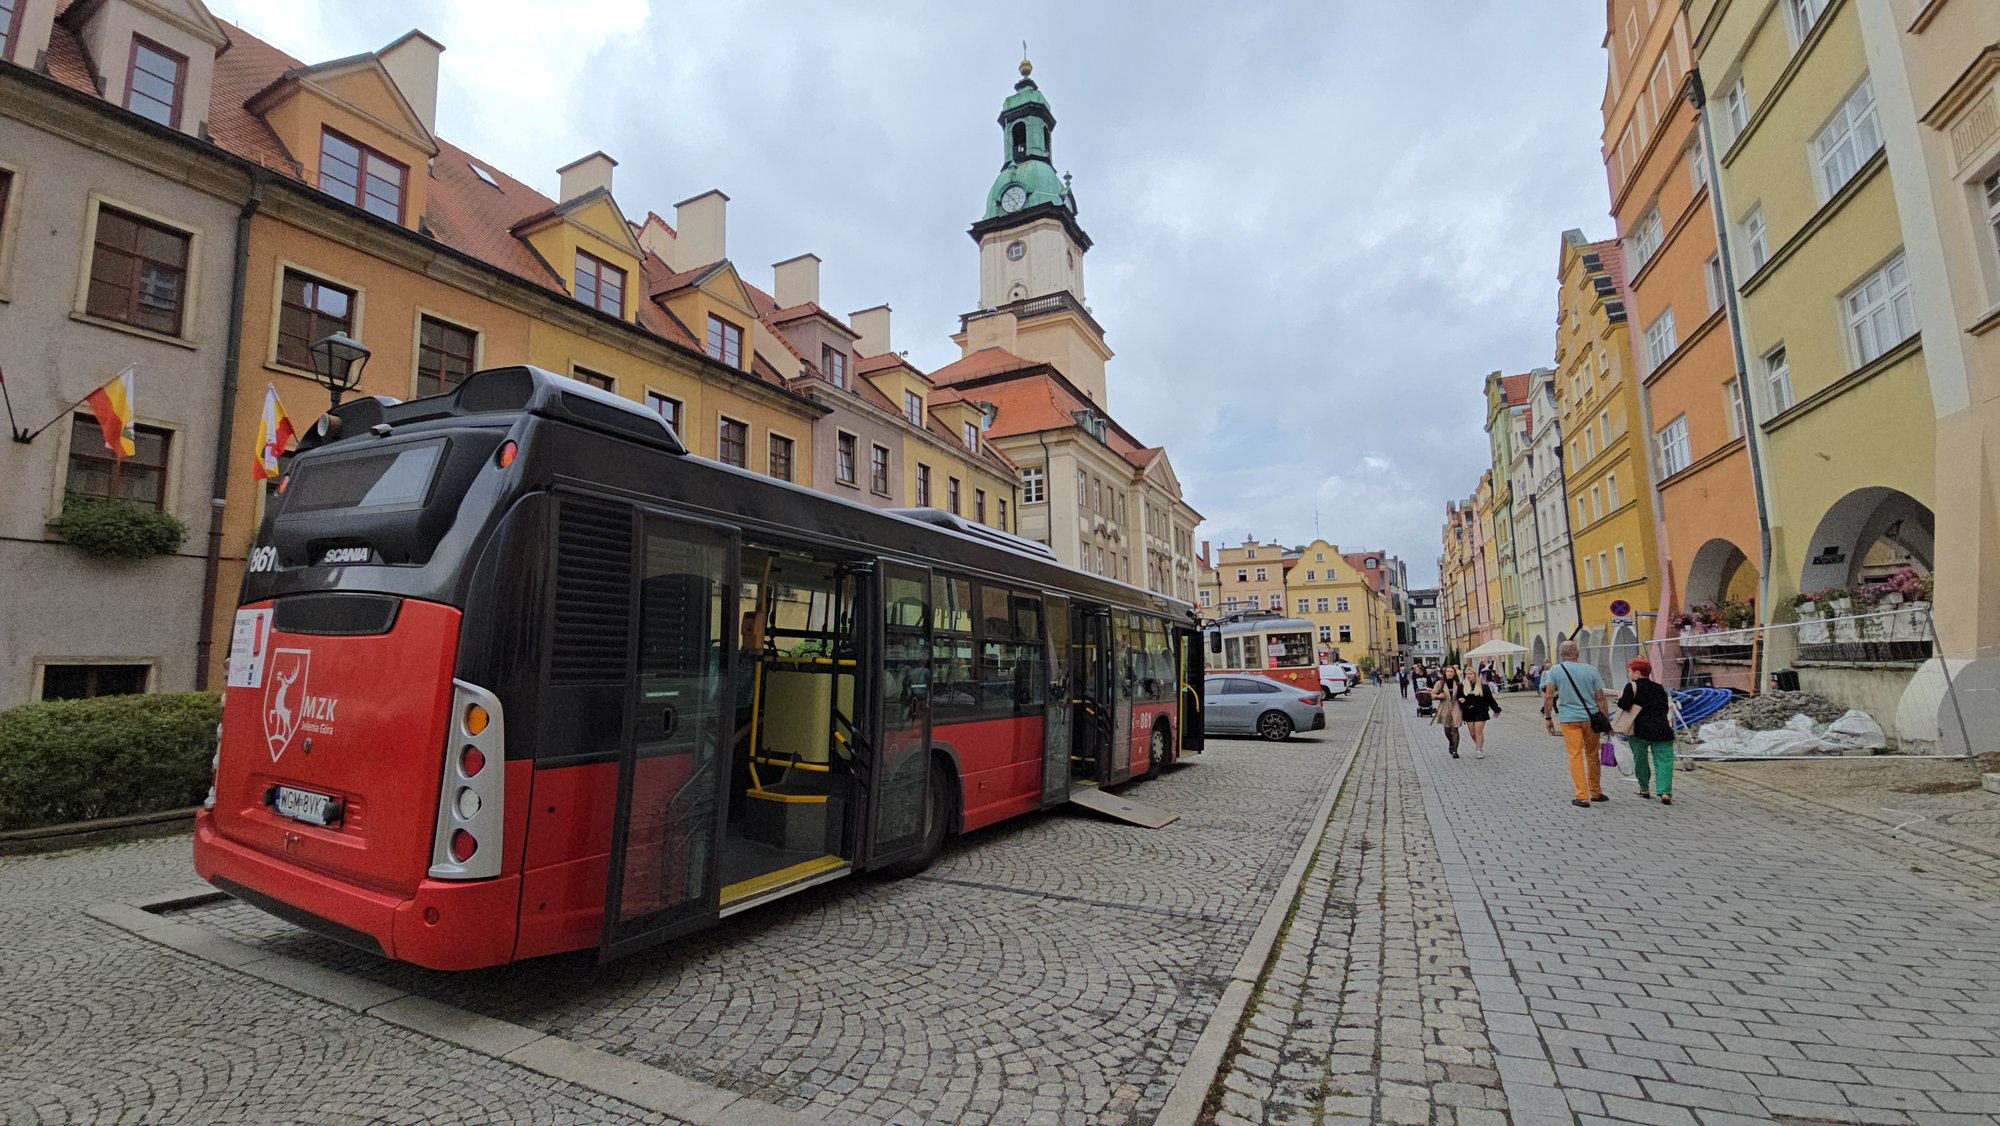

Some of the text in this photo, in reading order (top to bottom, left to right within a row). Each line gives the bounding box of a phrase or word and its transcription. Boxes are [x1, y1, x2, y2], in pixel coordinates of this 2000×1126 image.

[250, 546, 277, 573] 861
[324, 547, 369, 563] SCANIA
[302, 695, 338, 722] MZK
[301, 720, 320, 733] Jelenia
[1140, 711, 1151, 729] 861
[281, 789, 301, 812] WGM
